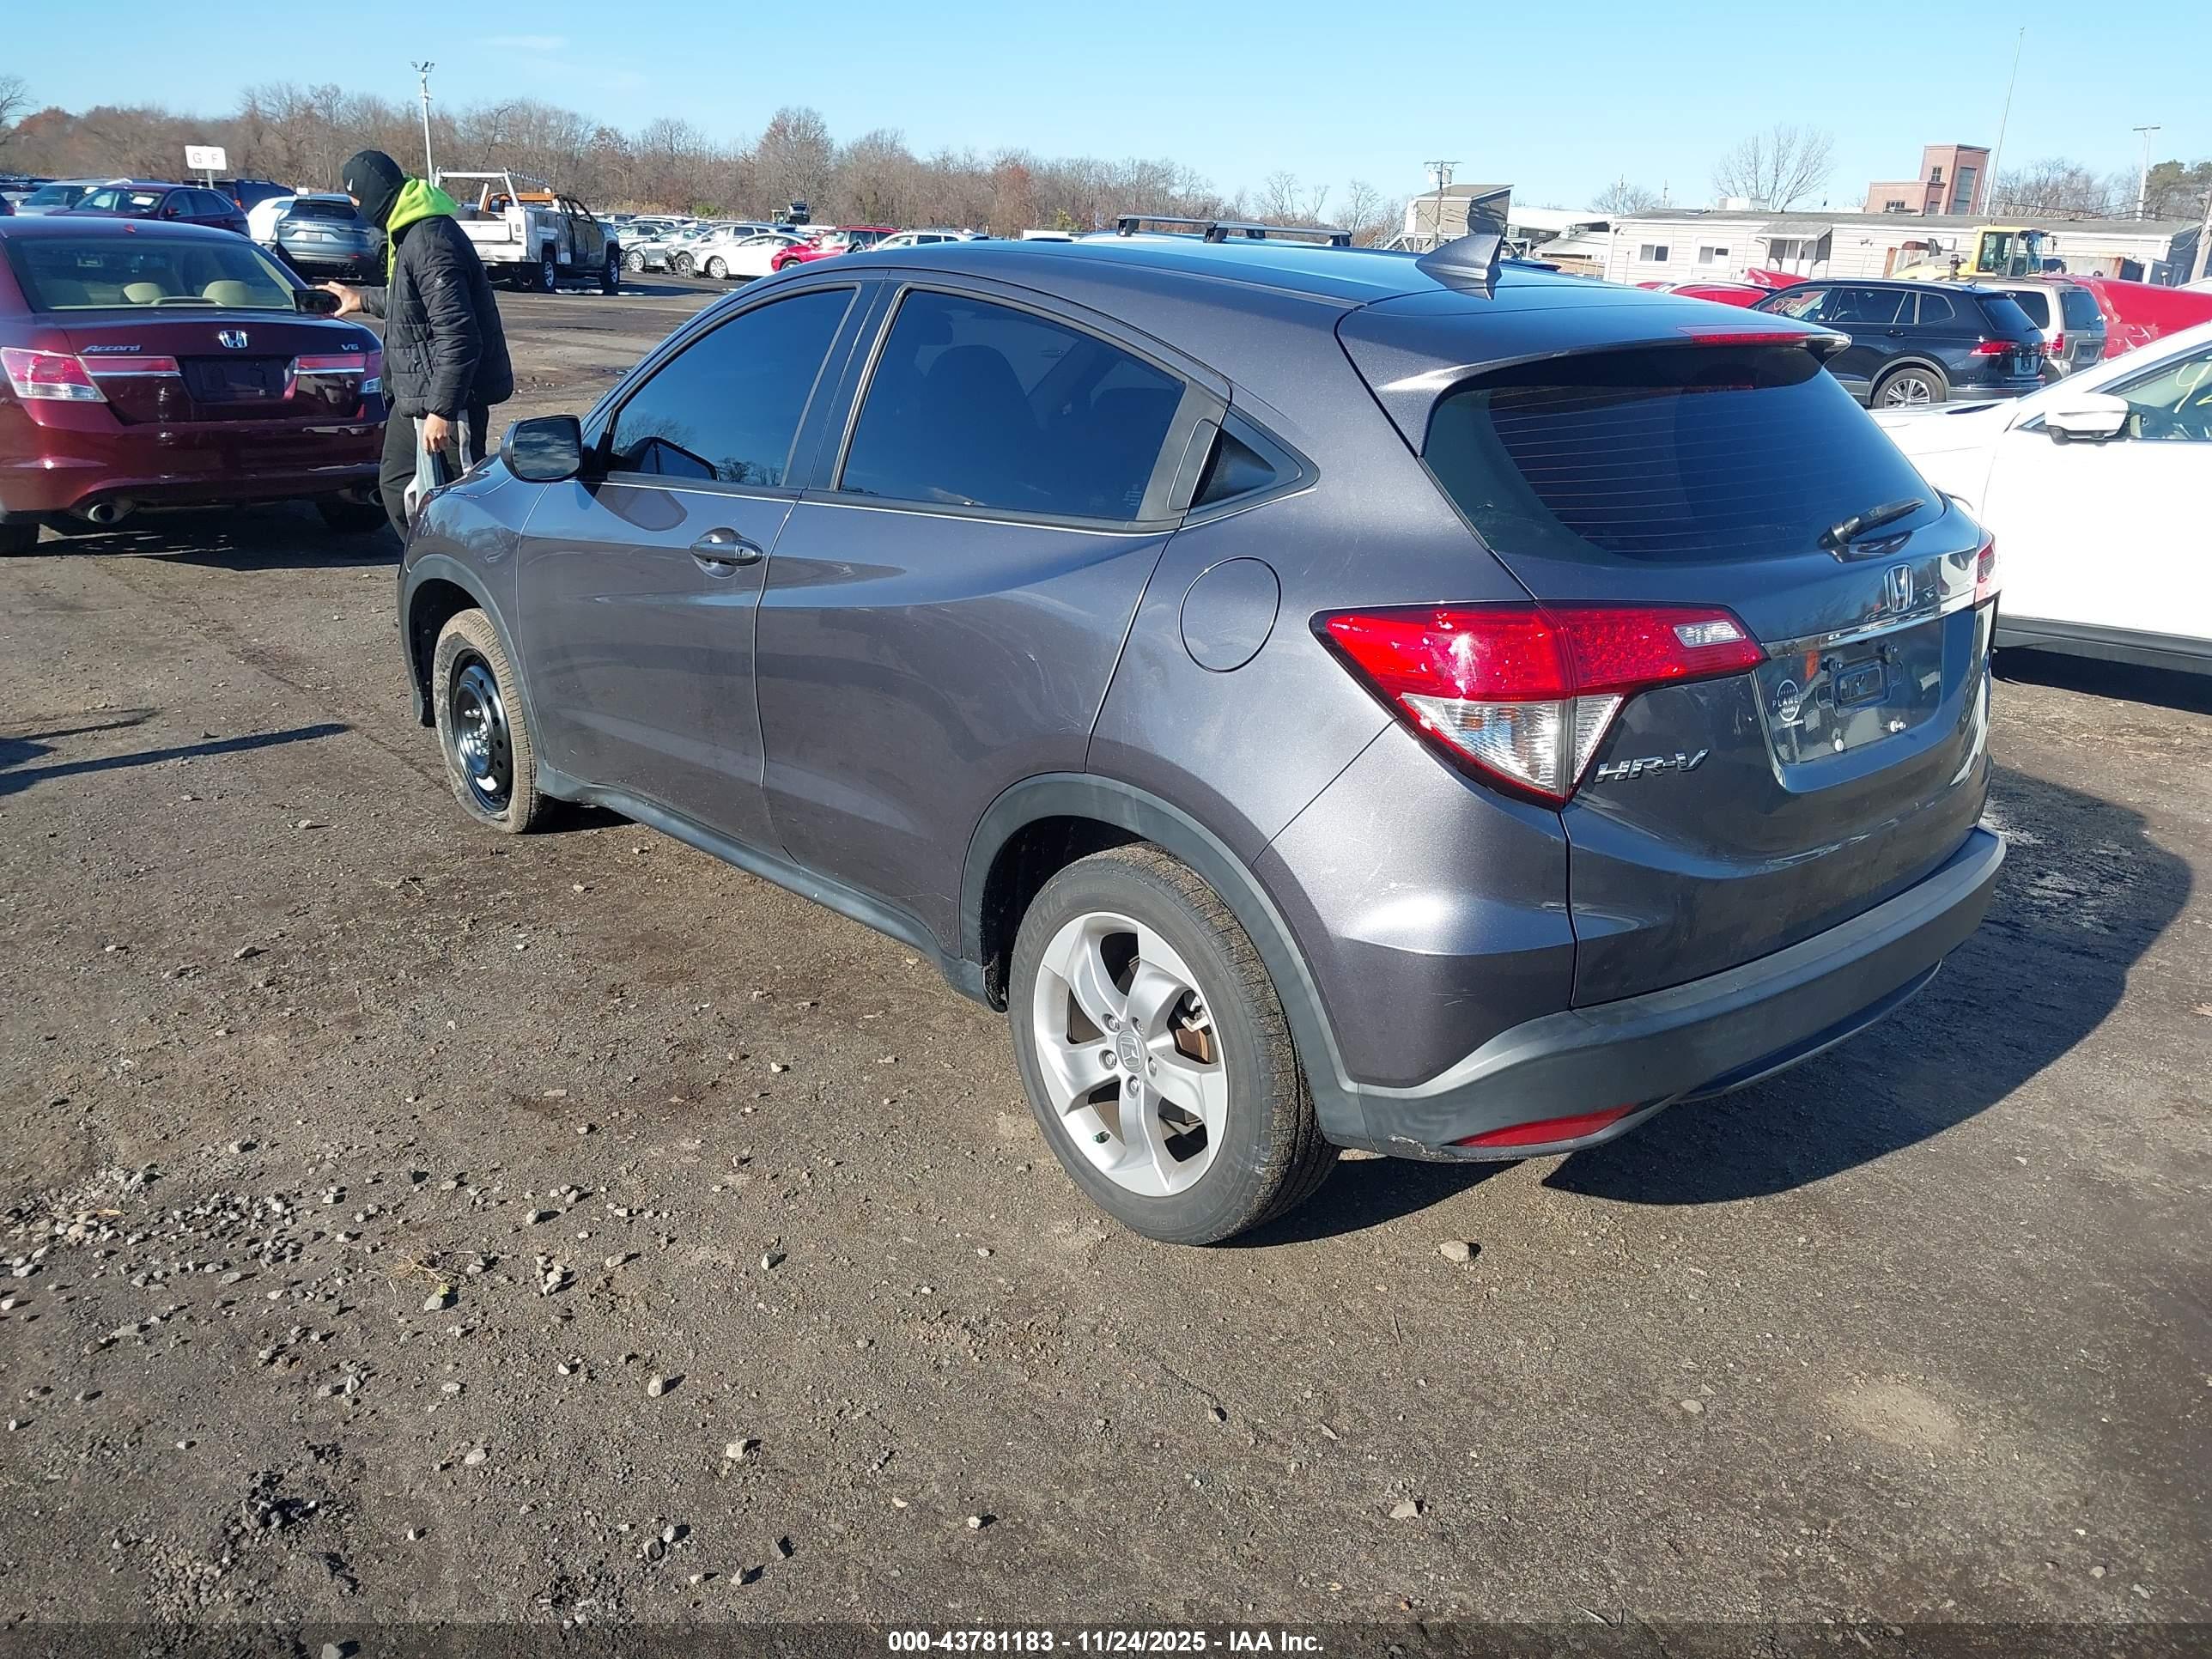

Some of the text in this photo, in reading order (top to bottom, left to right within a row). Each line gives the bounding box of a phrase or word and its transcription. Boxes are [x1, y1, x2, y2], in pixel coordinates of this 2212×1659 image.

[192, 152, 218, 164] G F
[82, 344, 142, 354] Accord
[1594, 748, 1710, 783] HR-V
